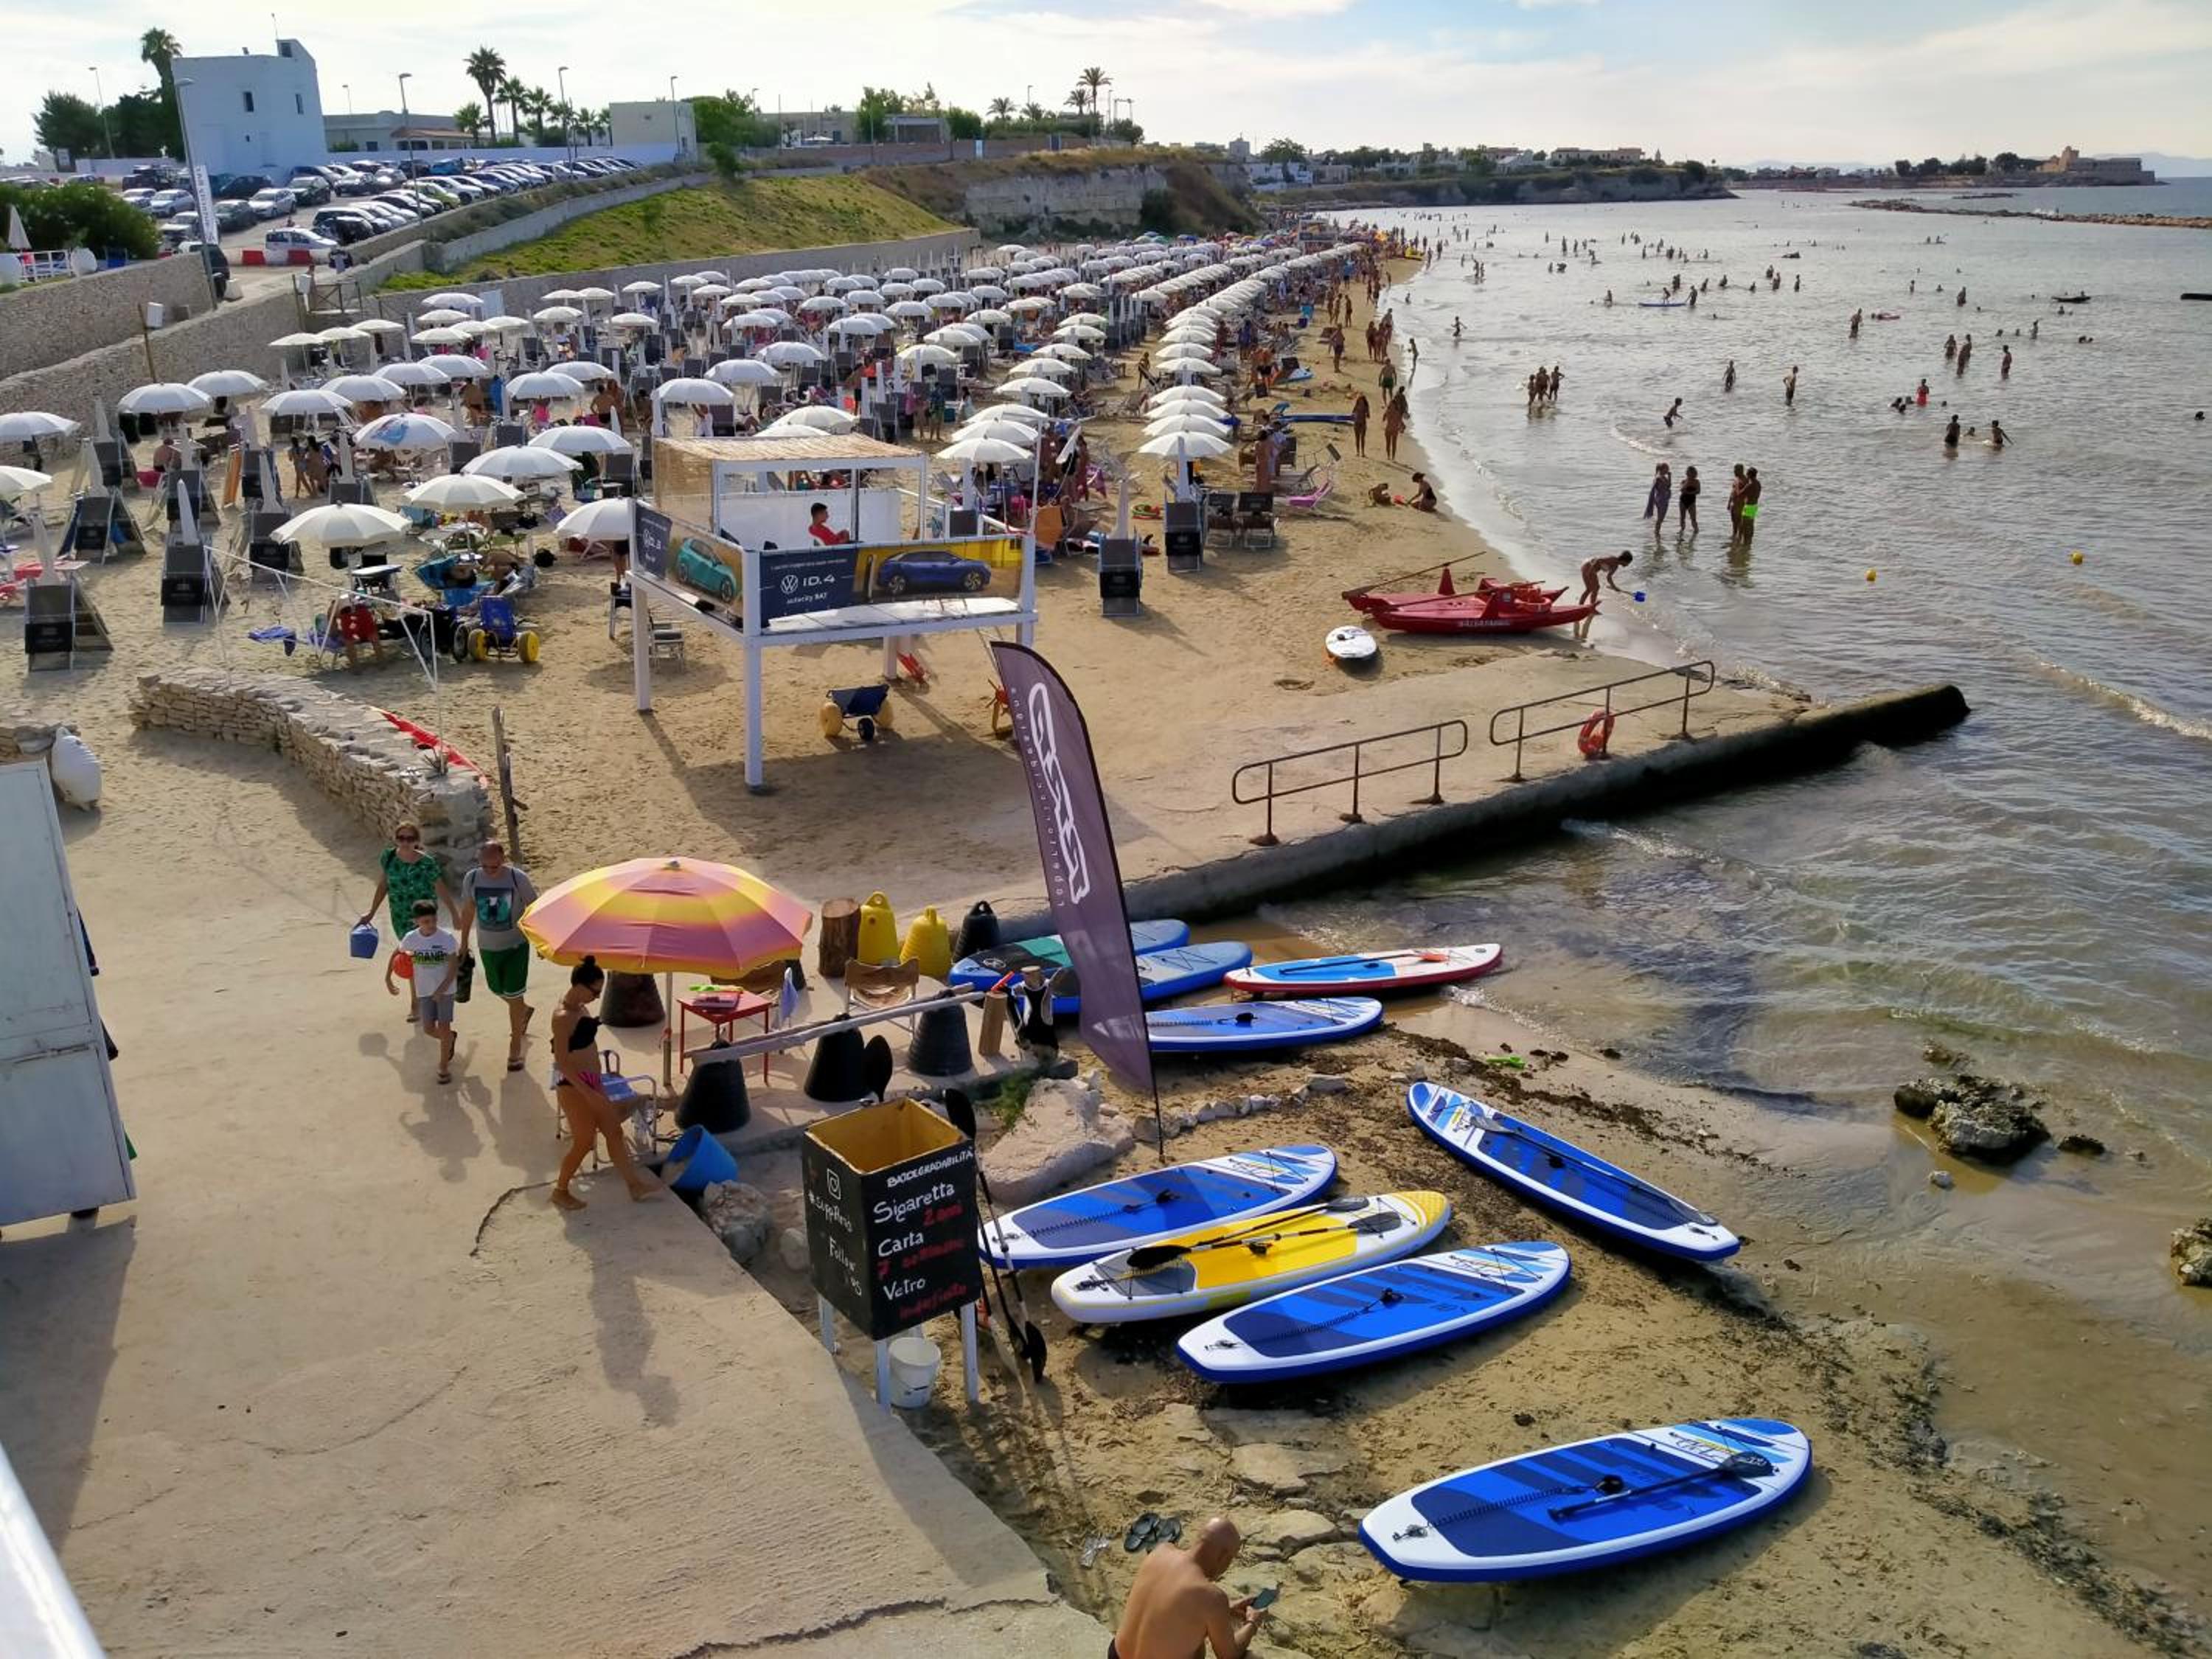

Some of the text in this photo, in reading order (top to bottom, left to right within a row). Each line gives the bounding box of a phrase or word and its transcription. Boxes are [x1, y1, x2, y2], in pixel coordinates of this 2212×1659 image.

[803, 574, 835, 587] ID.4
[873, 1182, 956, 1223] Sigaretta
[878, 1232, 924, 1256] Carta
[883, 1278, 926, 1300] Vetro
